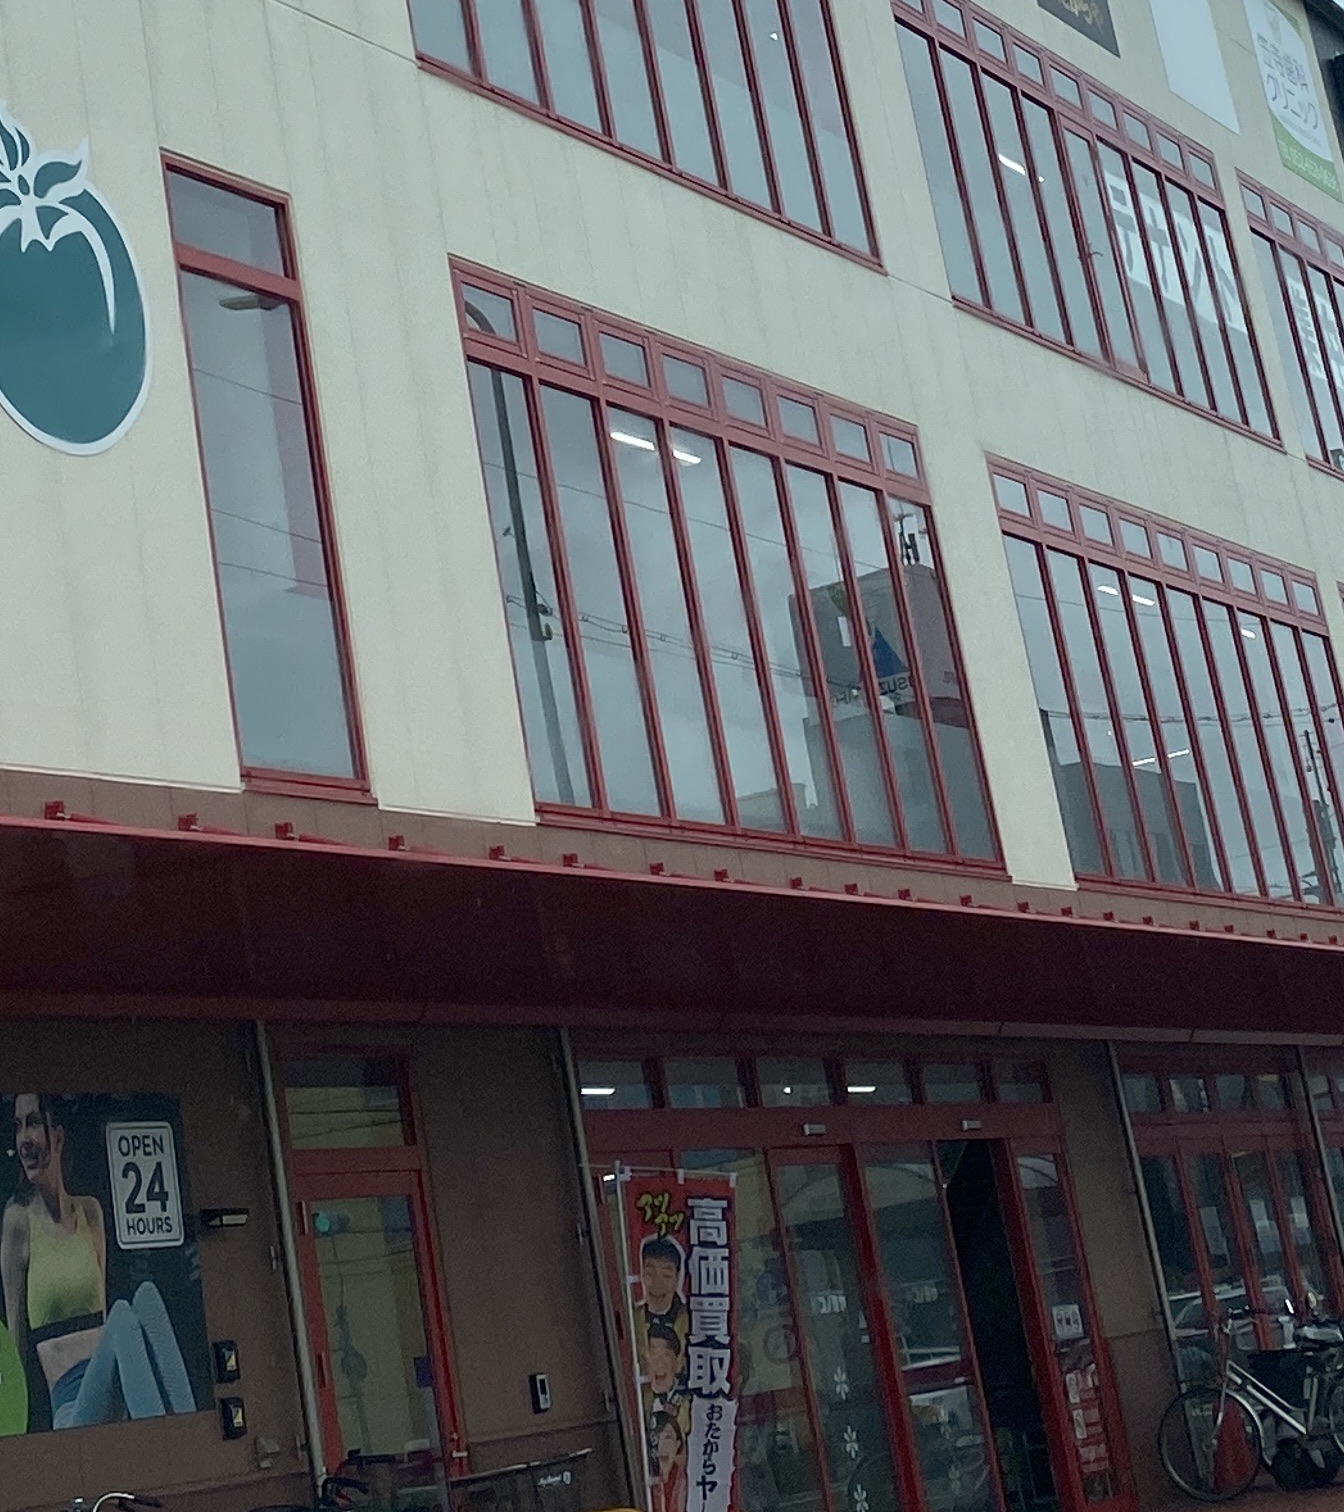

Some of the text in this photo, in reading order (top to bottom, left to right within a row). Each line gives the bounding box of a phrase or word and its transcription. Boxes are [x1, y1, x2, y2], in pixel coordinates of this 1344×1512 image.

[118, 1134, 165, 1157] OPEN
[121, 1161, 169, 1215] 24
[126, 1216, 173, 1236] HOURS
[687, 1197, 732, 1396] 高価買取
